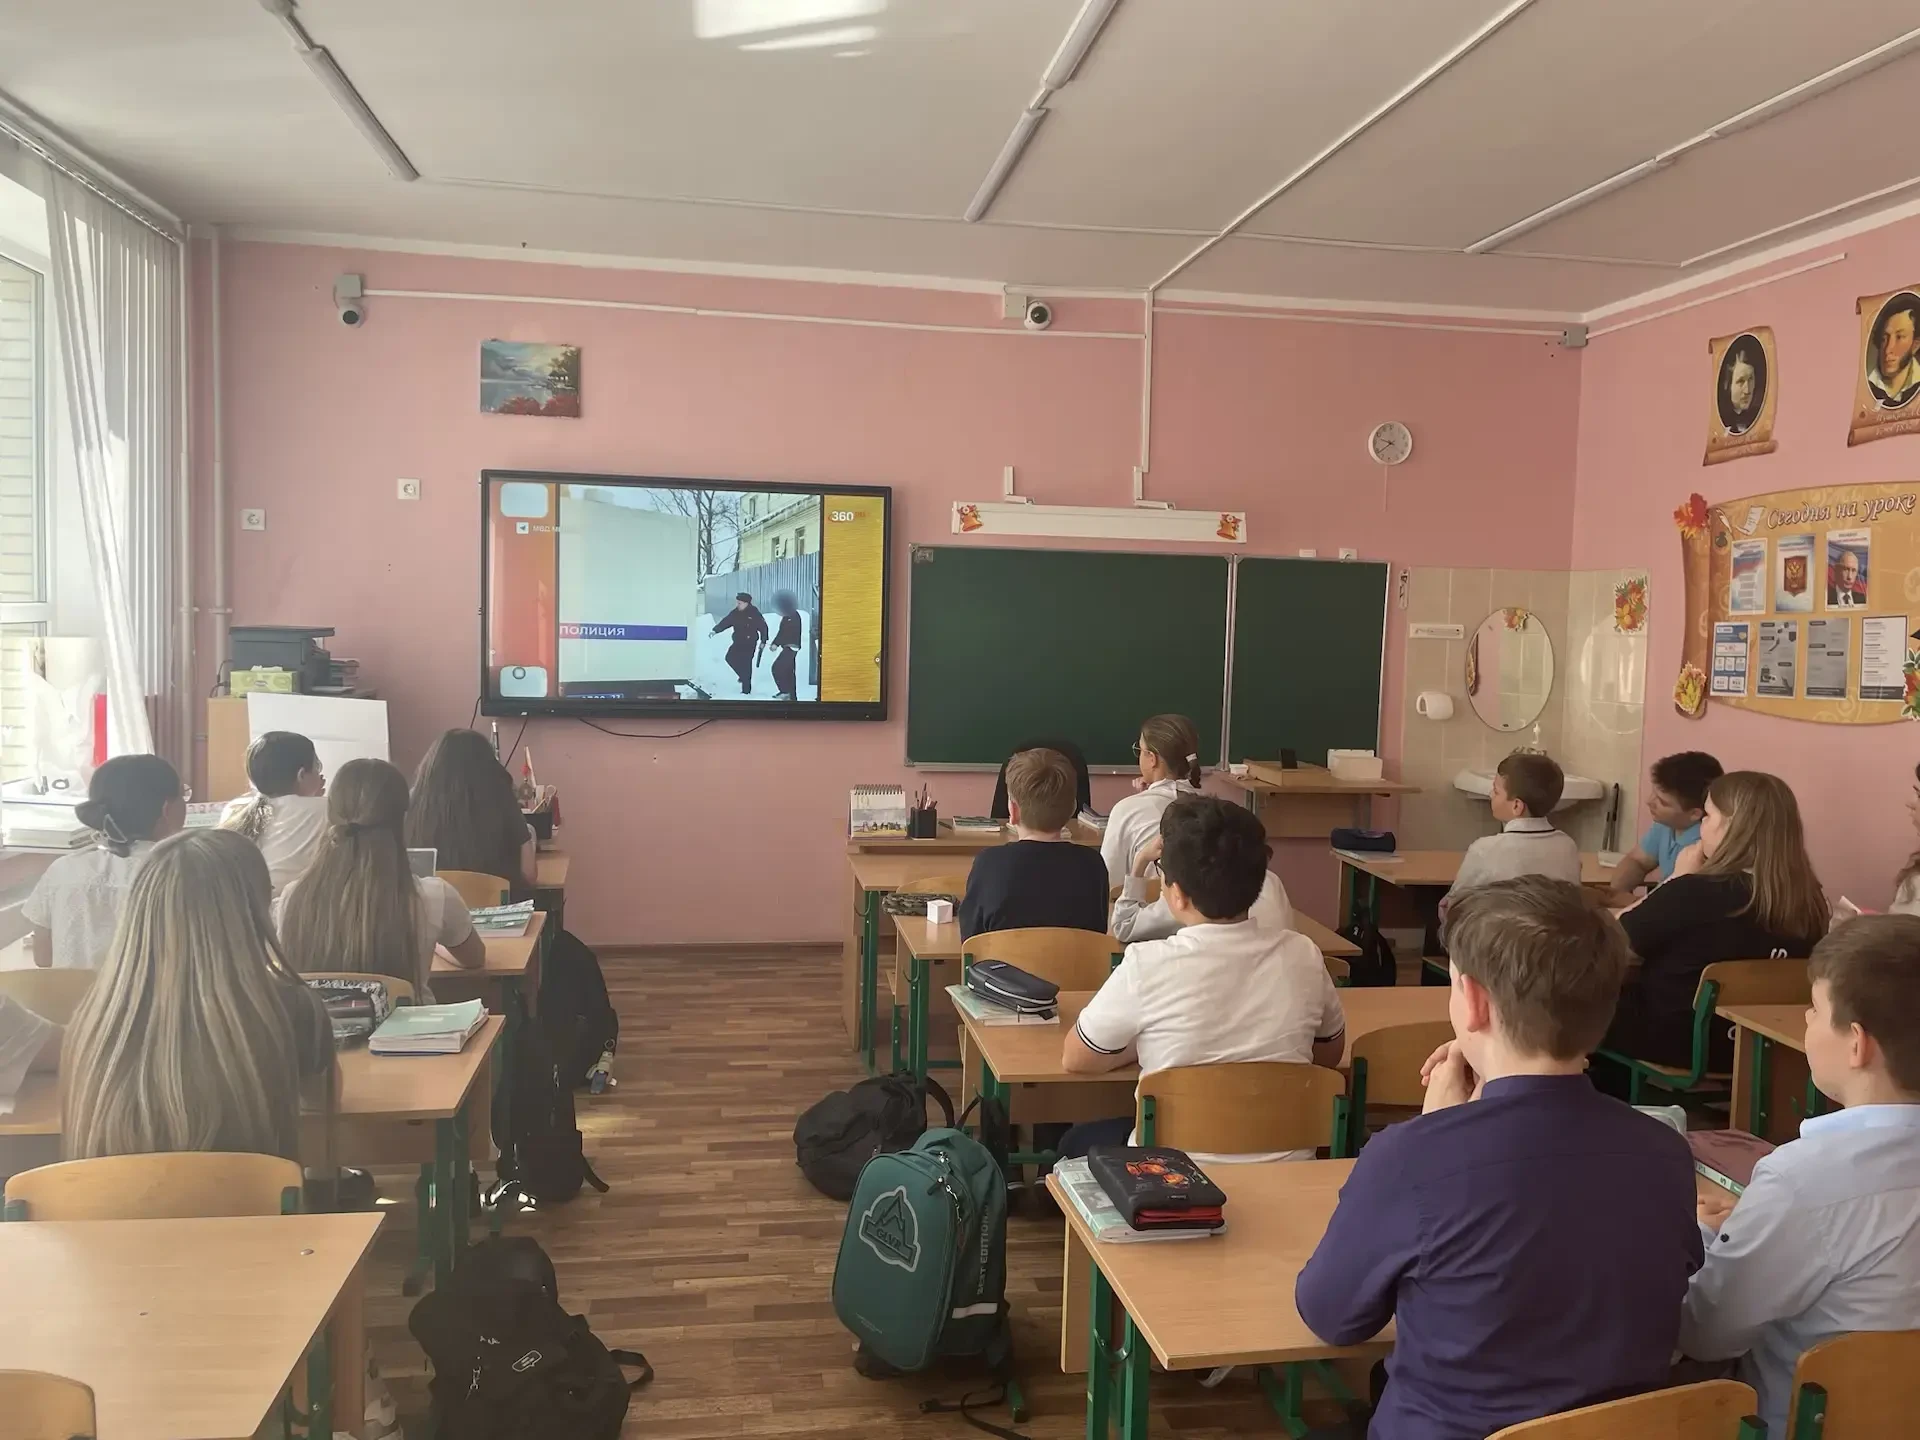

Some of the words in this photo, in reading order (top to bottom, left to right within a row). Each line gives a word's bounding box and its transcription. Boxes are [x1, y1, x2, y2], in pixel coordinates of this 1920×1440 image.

[831, 510, 854, 522] 360
[1766, 500, 1831, 529] Сегодня
[1835, 501, 1857, 517] на
[1860, 493, 1917, 523] уроке
[559, 625, 626, 637] ПОЛИЦИЯ
